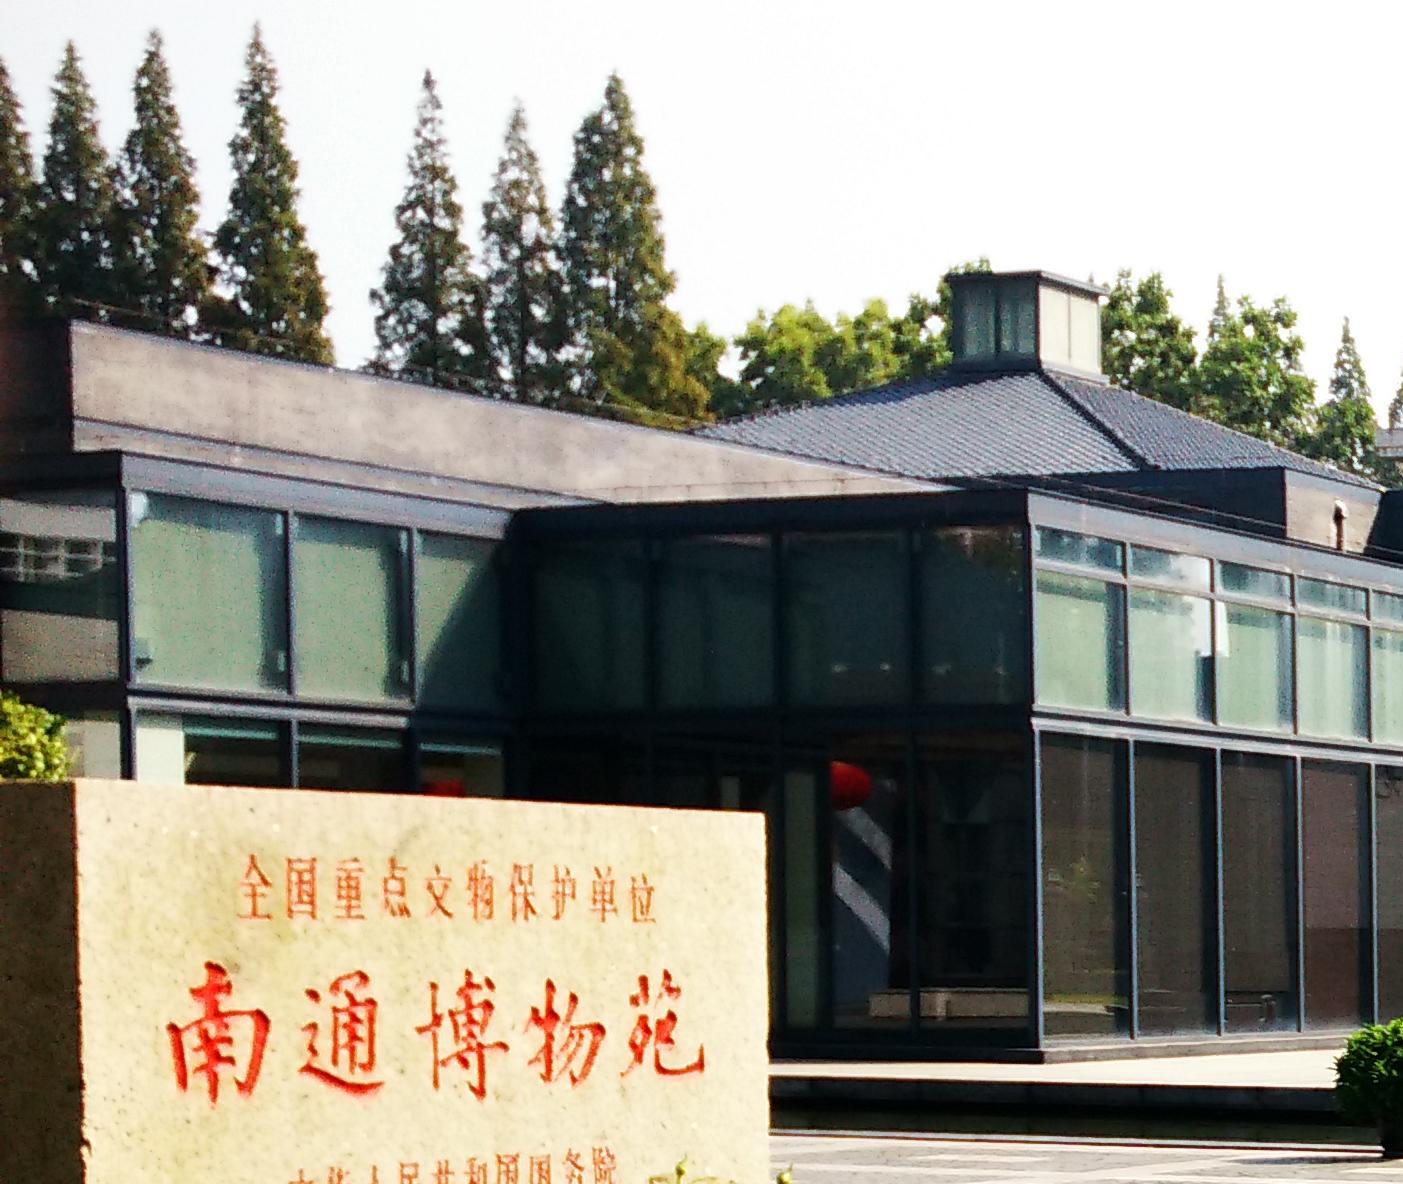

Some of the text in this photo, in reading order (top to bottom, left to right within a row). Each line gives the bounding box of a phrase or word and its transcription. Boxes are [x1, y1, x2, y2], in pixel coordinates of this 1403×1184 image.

[236, 853, 657, 925] 全国重点文物保护单位
[166, 960, 706, 1104] 南通博物苑
